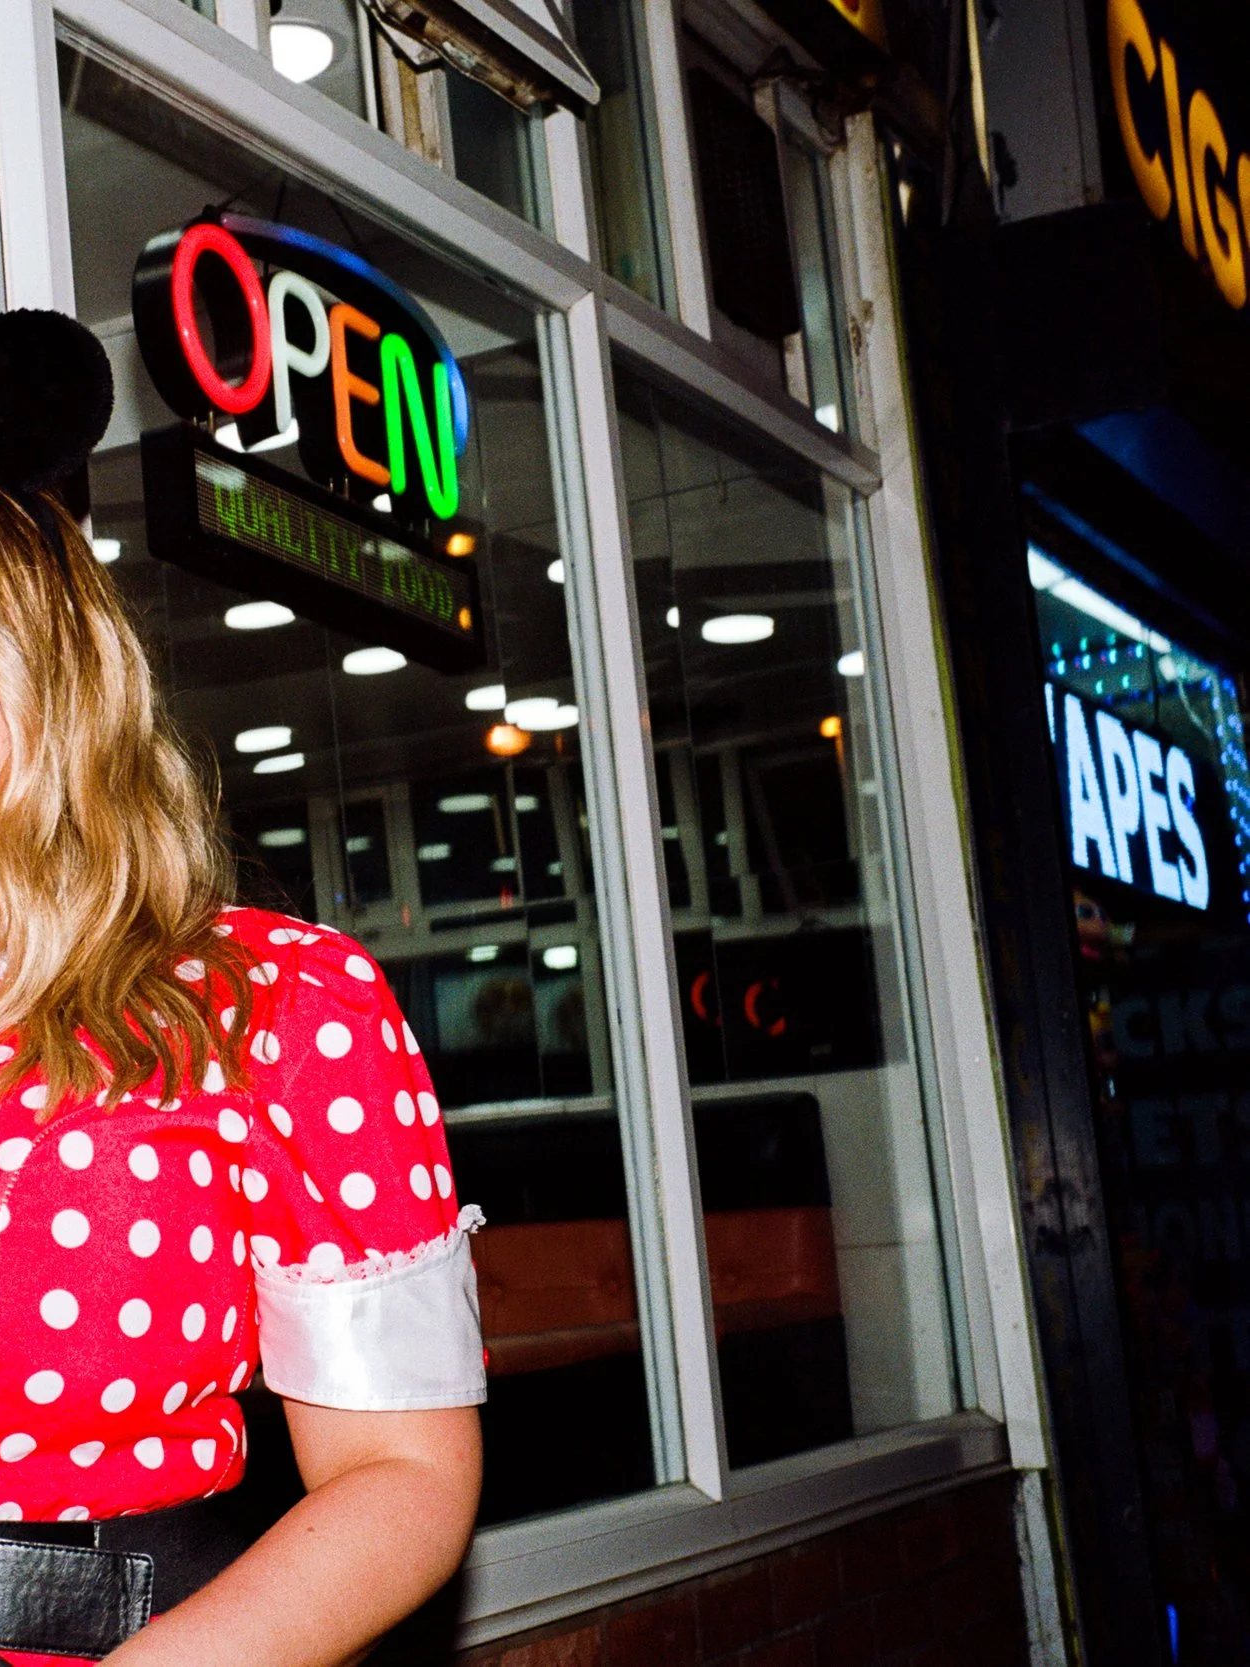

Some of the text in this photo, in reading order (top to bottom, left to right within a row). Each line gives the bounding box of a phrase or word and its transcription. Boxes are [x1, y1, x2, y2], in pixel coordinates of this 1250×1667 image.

[1107, 0, 1250, 310] CIG
[171, 223, 458, 520] OPEN
[1045, 683, 1209, 911] APES
